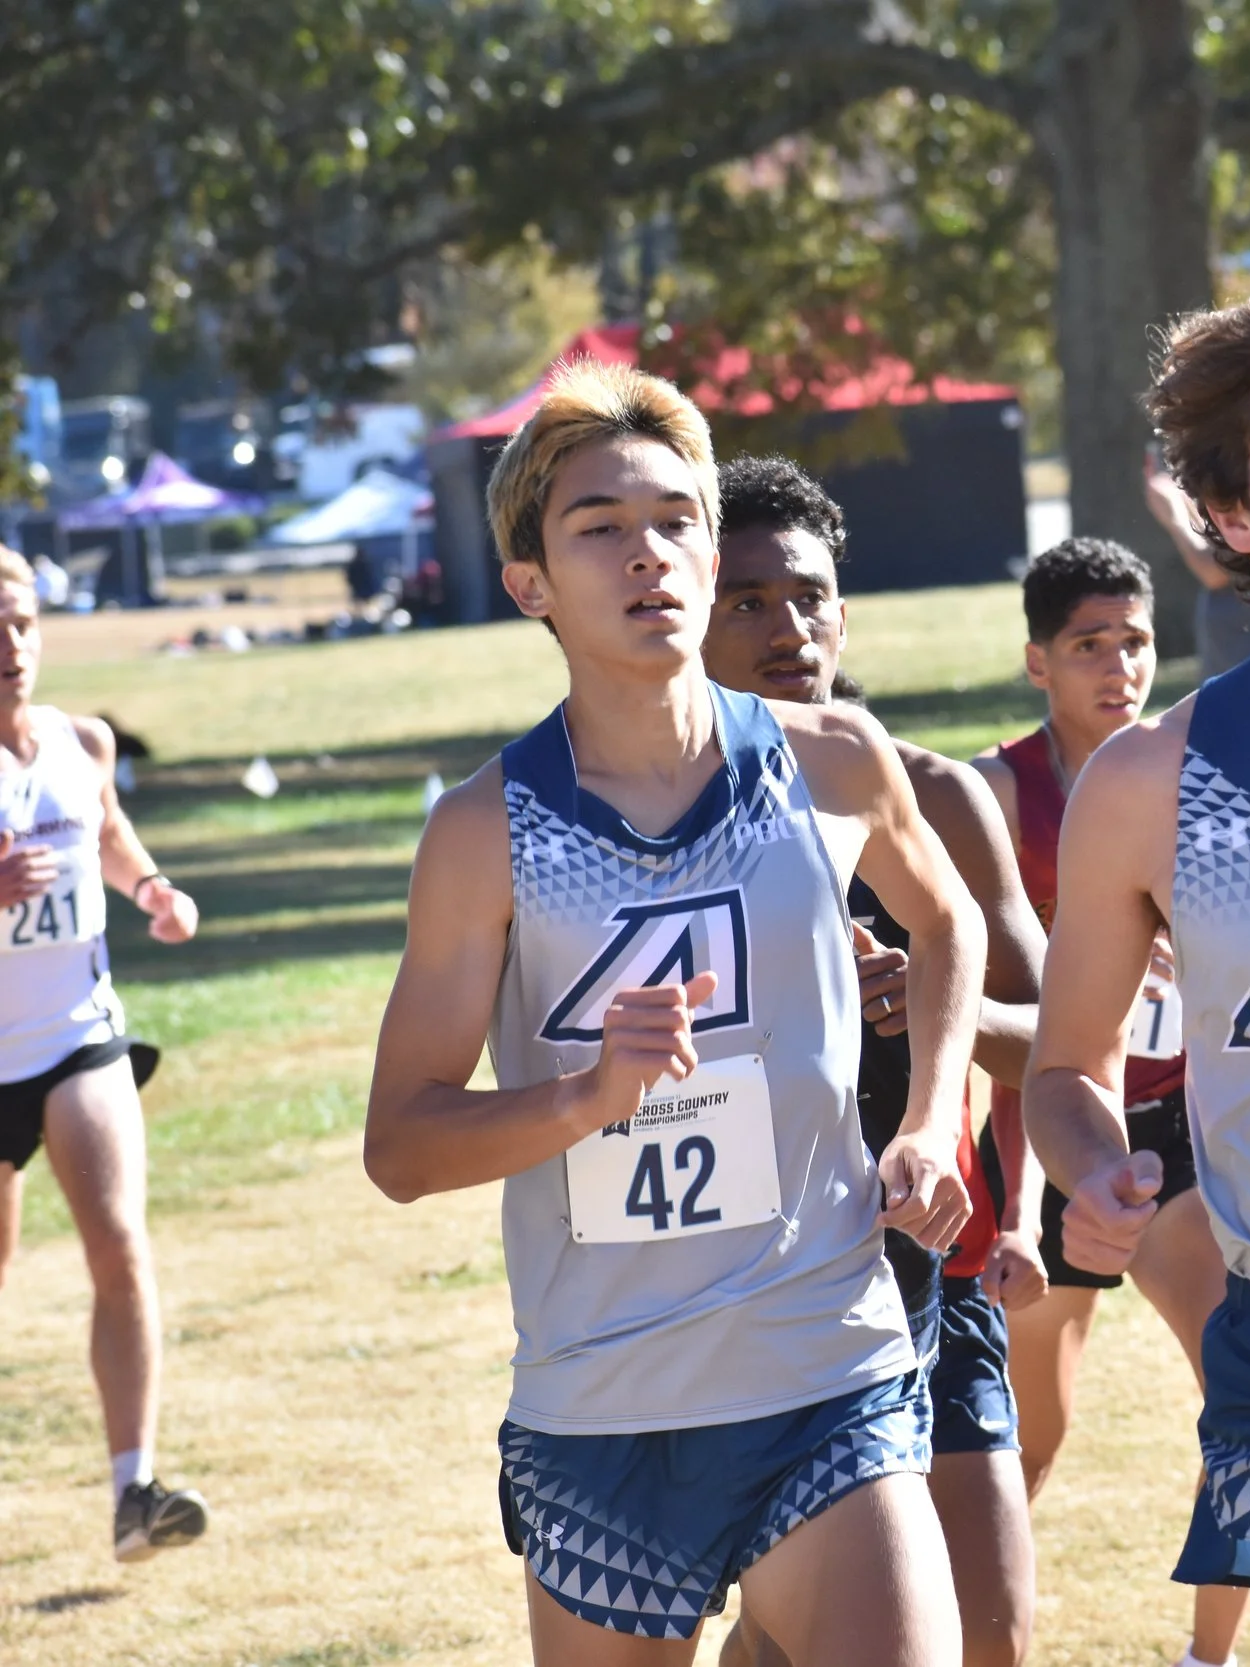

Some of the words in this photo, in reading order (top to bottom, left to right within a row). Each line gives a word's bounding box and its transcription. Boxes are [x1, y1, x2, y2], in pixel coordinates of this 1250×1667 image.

[8, 889, 78, 945] 241
[534, 883, 753, 1045] A
[634, 1110, 699, 1127] CHAMPIONSHIPS
[635, 1102, 674, 1118] CROSS
[677, 1091, 729, 1112] COUNTRY
[625, 1134, 721, 1231] 42
